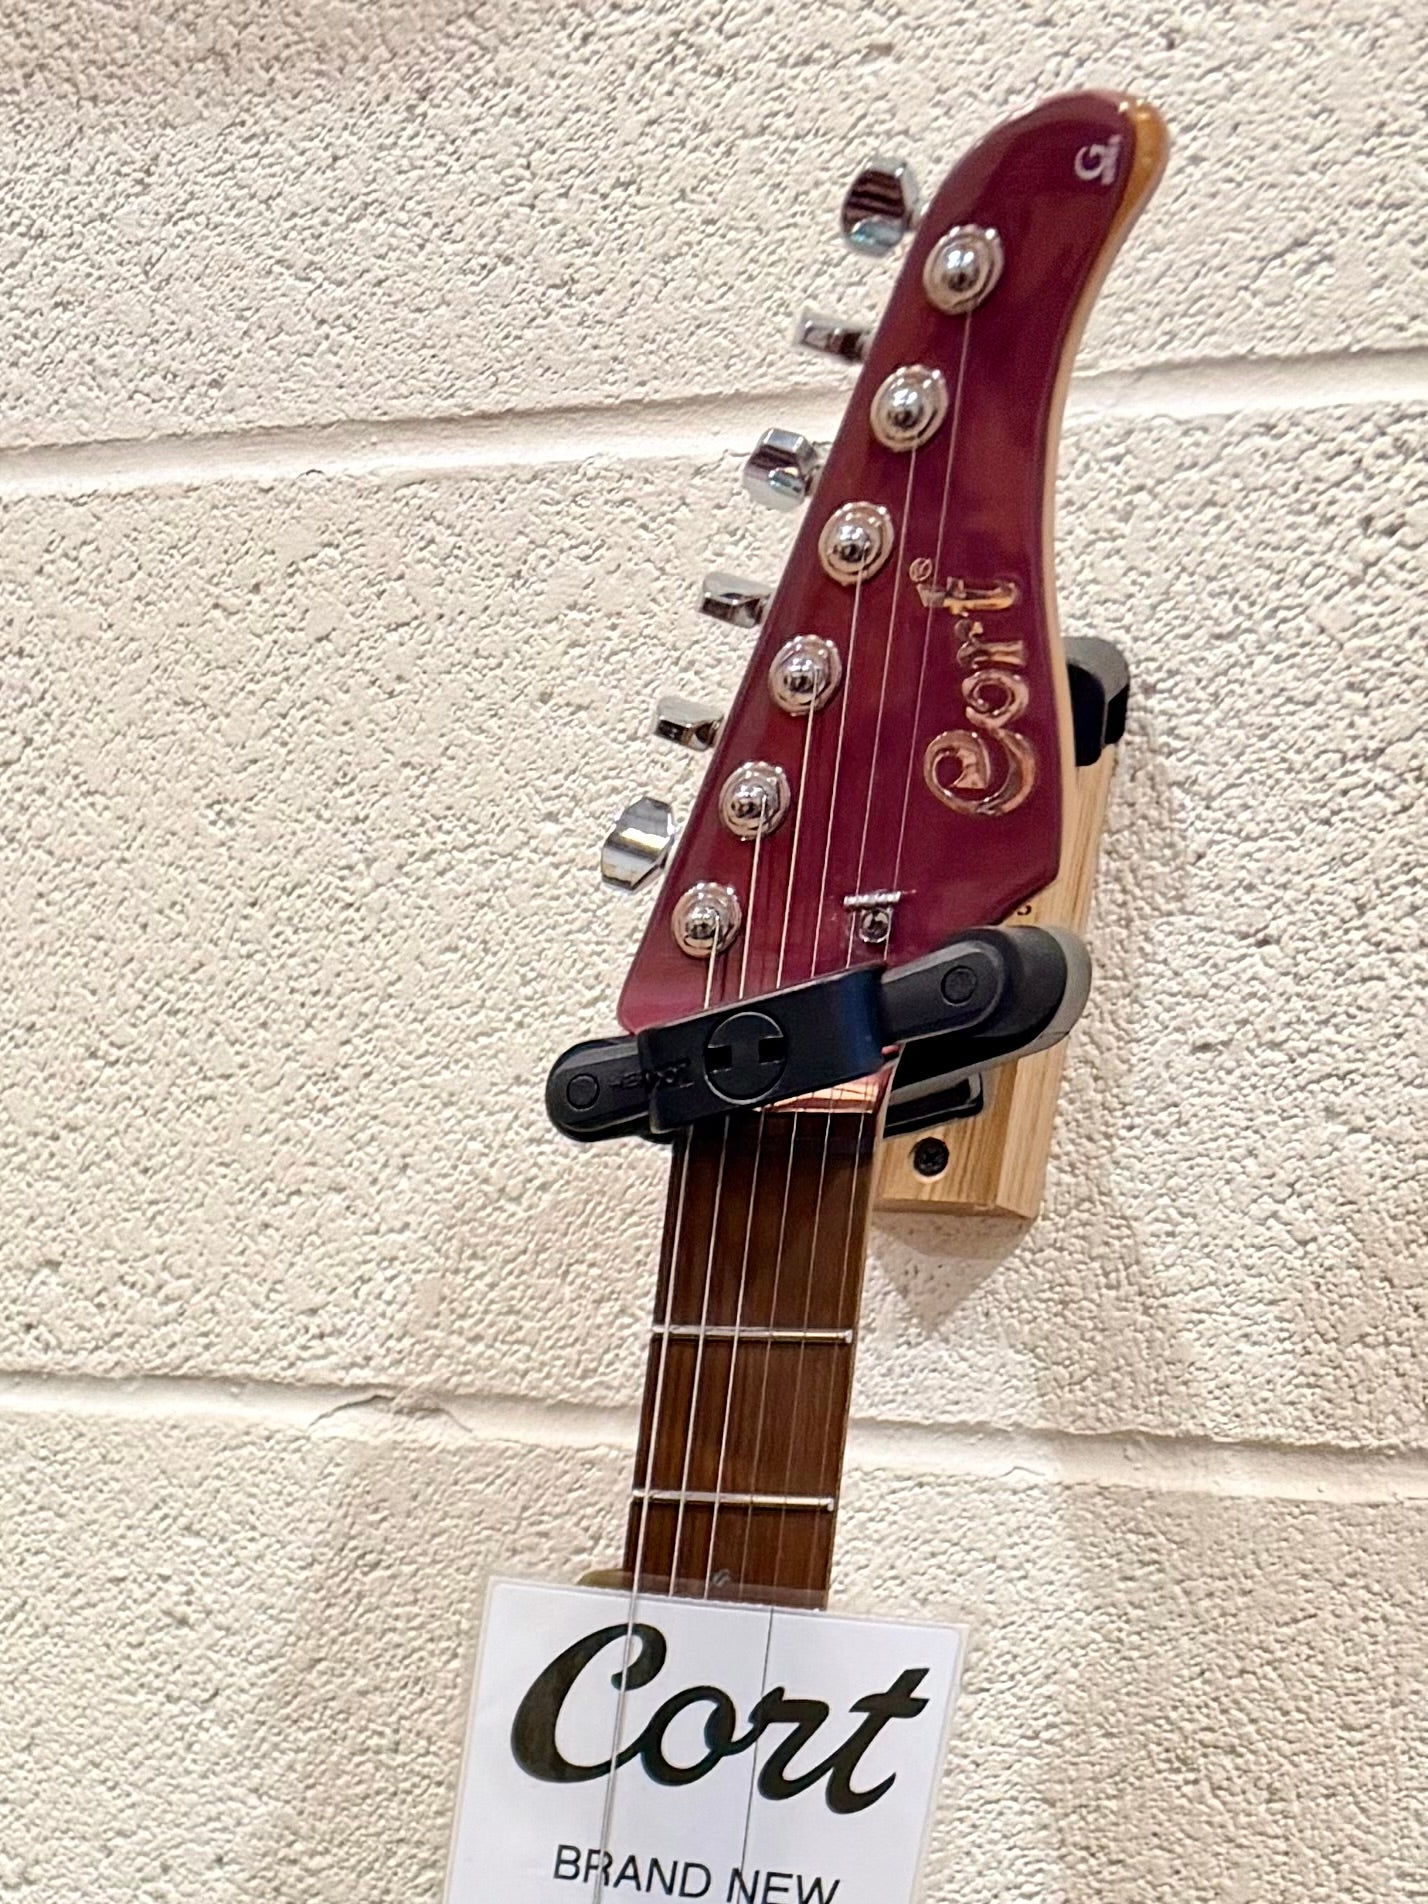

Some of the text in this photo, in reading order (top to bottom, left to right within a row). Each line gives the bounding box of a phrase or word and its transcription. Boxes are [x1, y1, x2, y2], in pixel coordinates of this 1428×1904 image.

[909, 557, 1036, 815] Cort
[511, 1622, 930, 1814] Cort
[553, 1843, 711, 1901] BRAND
